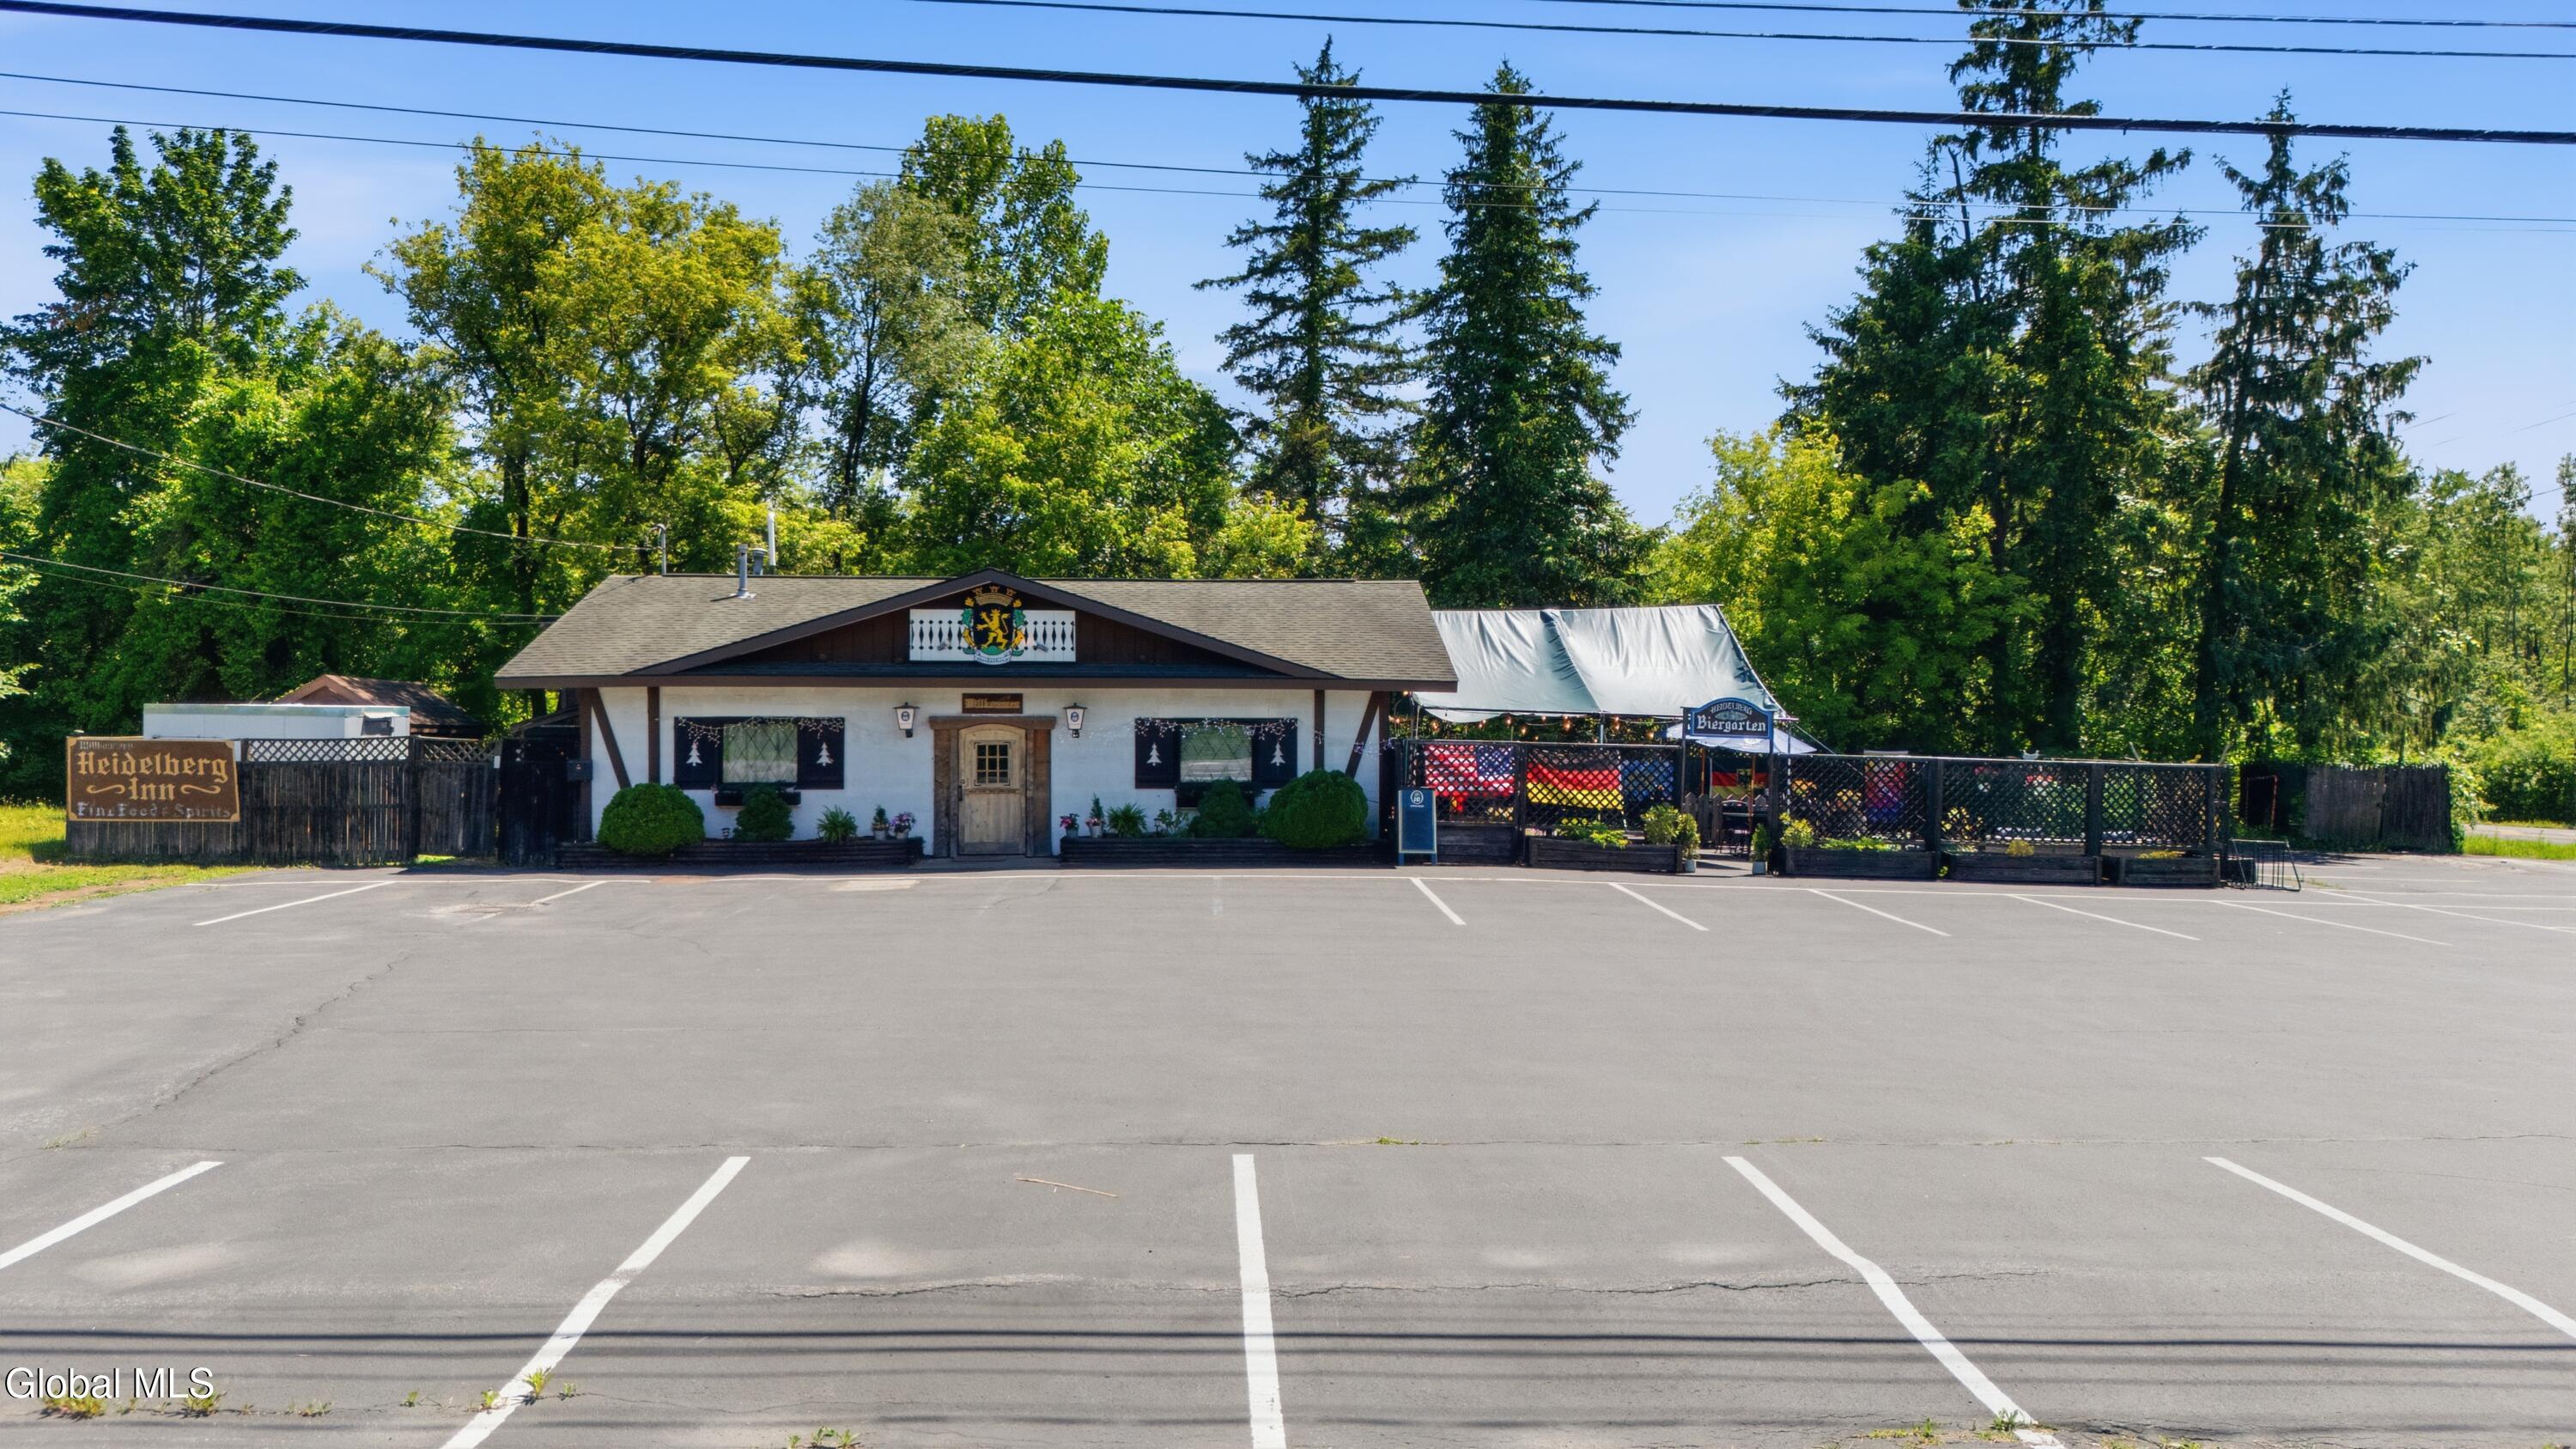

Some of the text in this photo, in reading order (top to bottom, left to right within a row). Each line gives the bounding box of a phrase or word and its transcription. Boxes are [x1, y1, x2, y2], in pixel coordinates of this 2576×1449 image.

[1697, 715, 1766, 732] Biergarten
[76, 751, 228, 784] Heidelberg
[128, 776, 176, 801] Inn
[173, 802, 232, 819] Spirits
